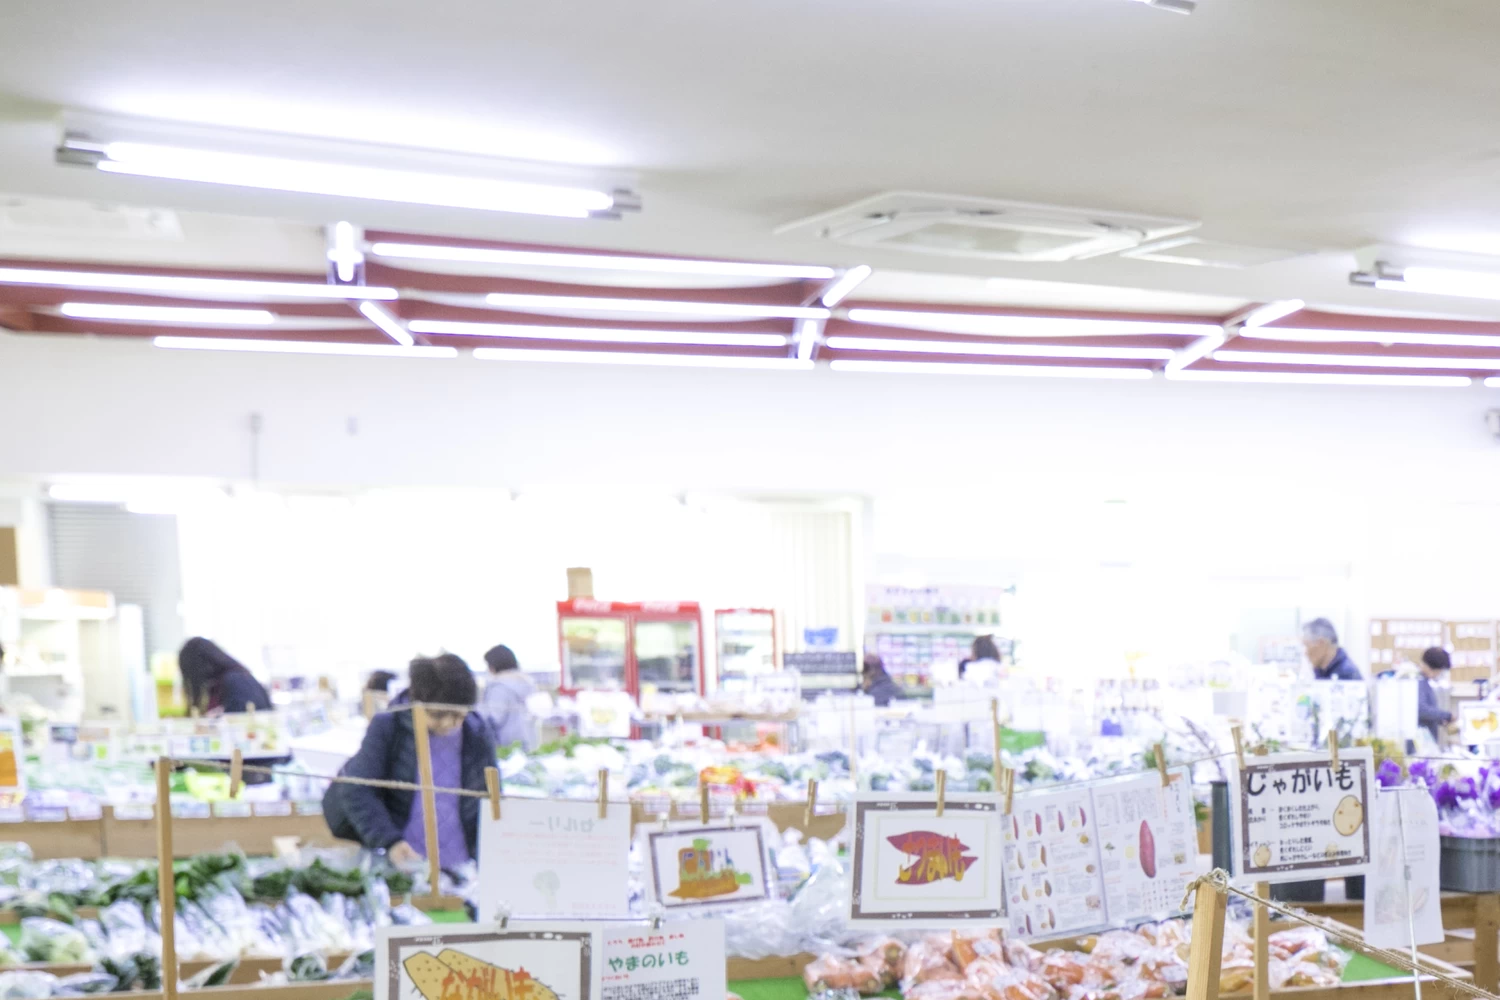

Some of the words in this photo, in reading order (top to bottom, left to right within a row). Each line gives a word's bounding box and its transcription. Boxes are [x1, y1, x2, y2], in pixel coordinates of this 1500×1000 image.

[1247, 764, 1354, 796] じゃがいも
[608, 950, 690, 973] やまのいも
